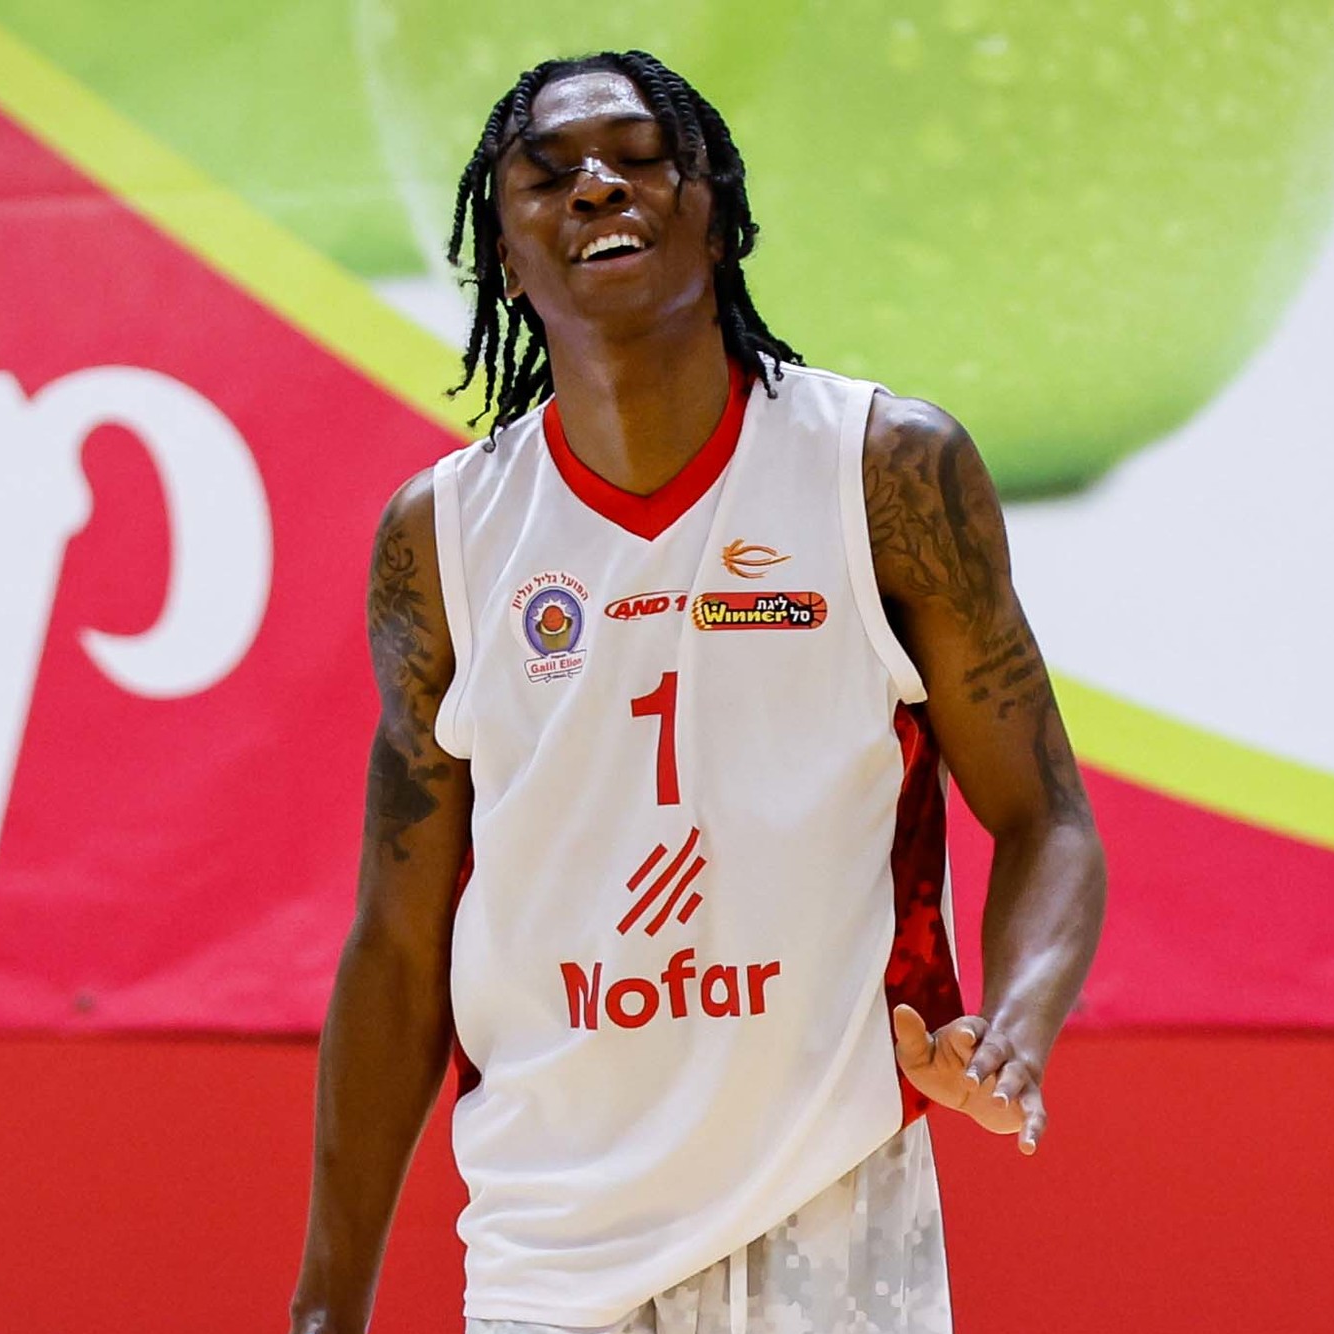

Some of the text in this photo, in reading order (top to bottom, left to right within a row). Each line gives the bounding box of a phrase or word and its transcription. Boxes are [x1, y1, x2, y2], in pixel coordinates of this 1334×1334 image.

[511, 572, 590, 611] הפועל גליל עליון
[613, 596, 688, 619] AND 1
[703, 602, 811, 623] Winner סל
[756, 596, 788, 611] ליגת
[530, 657, 583, 674] Galil Elion
[631, 671, 681, 806] 1
[559, 947, 781, 1031] Nofar
